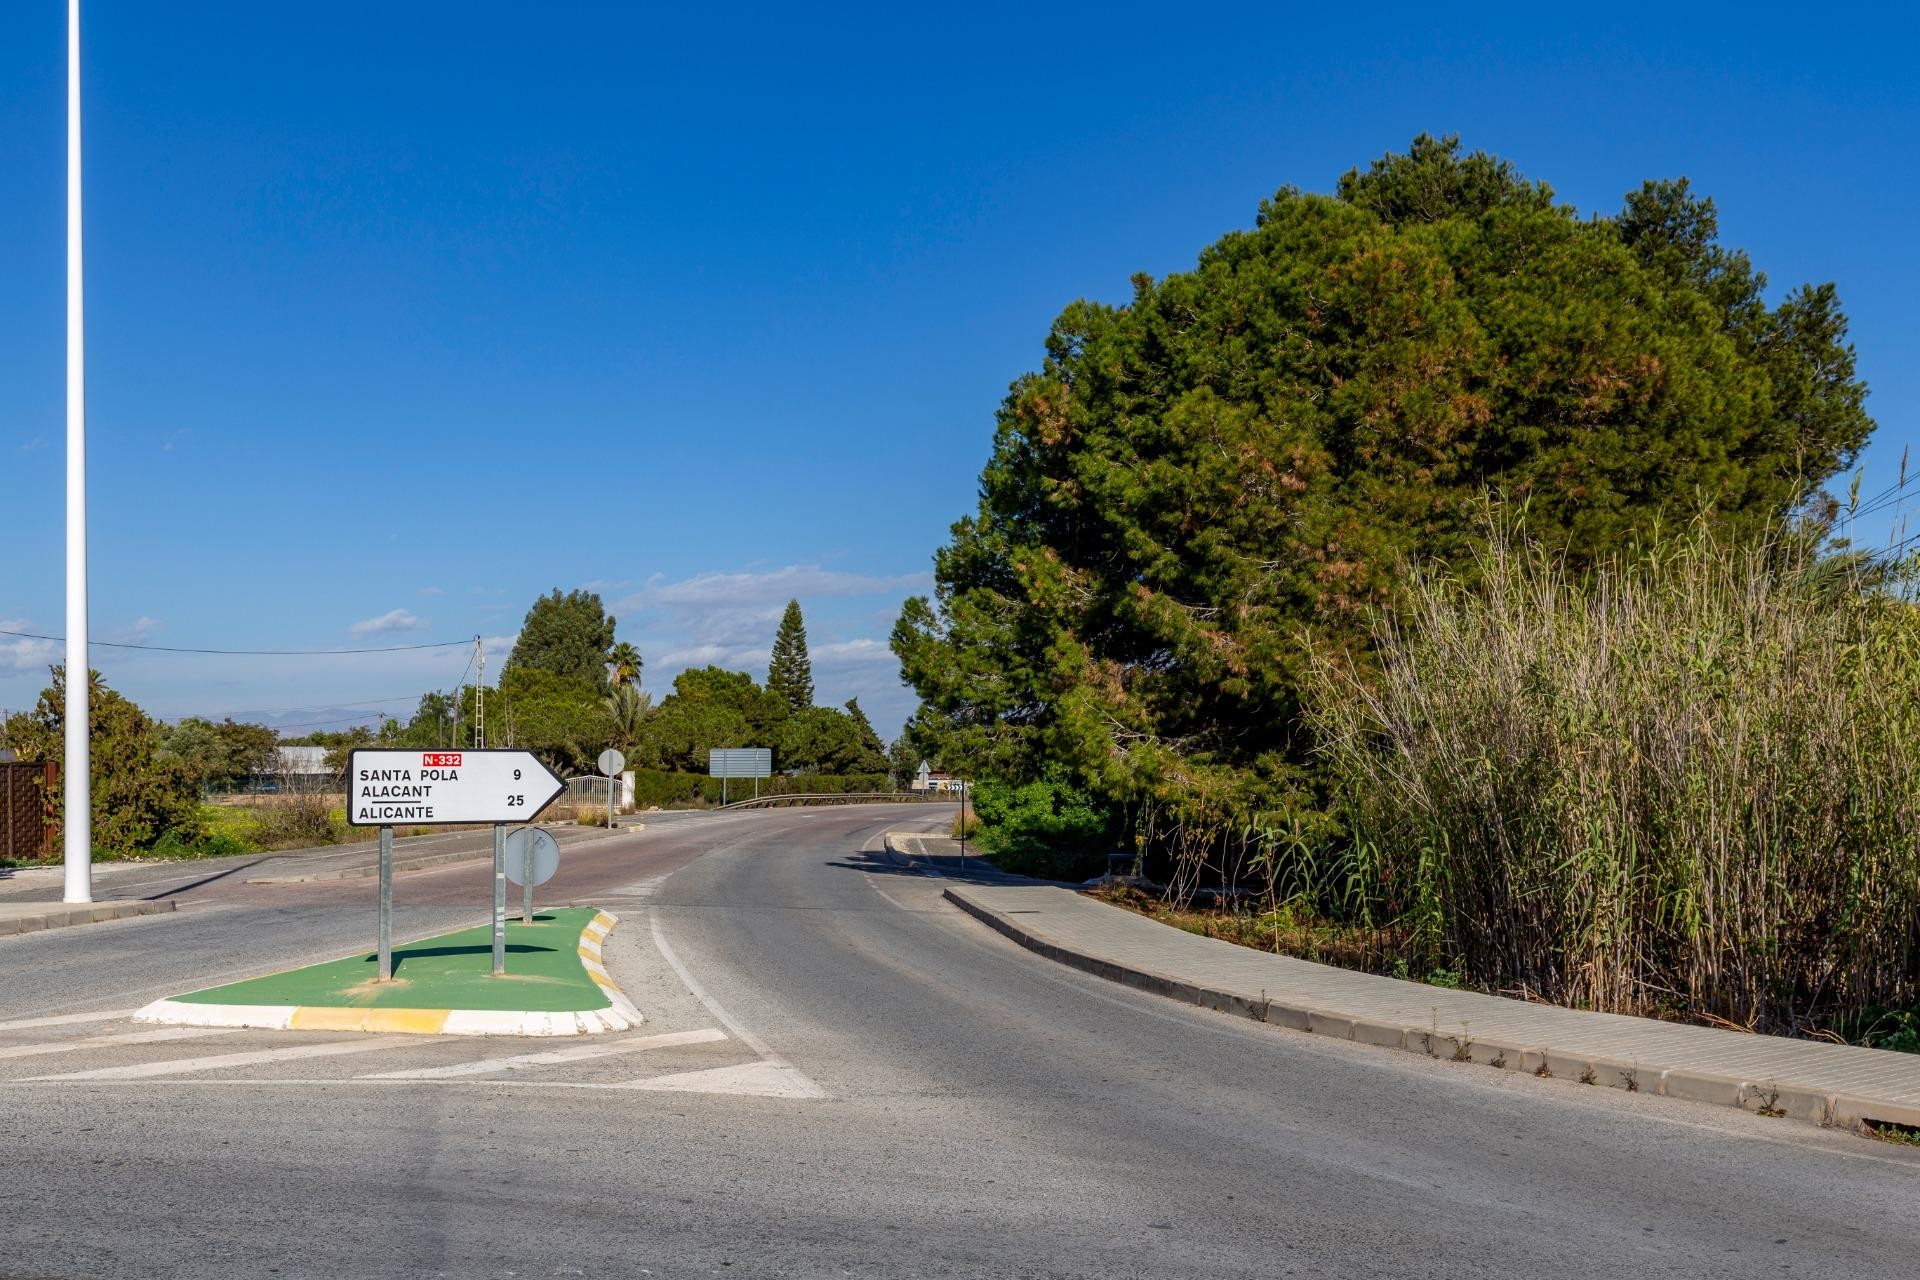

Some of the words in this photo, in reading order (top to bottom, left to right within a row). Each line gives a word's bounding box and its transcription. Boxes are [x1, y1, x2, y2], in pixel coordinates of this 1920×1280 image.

[424, 755, 461, 766] N-332
[360, 769, 411, 781] SANTA
[420, 769, 458, 781] POLA
[513, 769, 521, 780] 9
[361, 785, 432, 797] ALACANT
[507, 795, 524, 806] 25
[359, 806, 433, 819] ALICANTE
